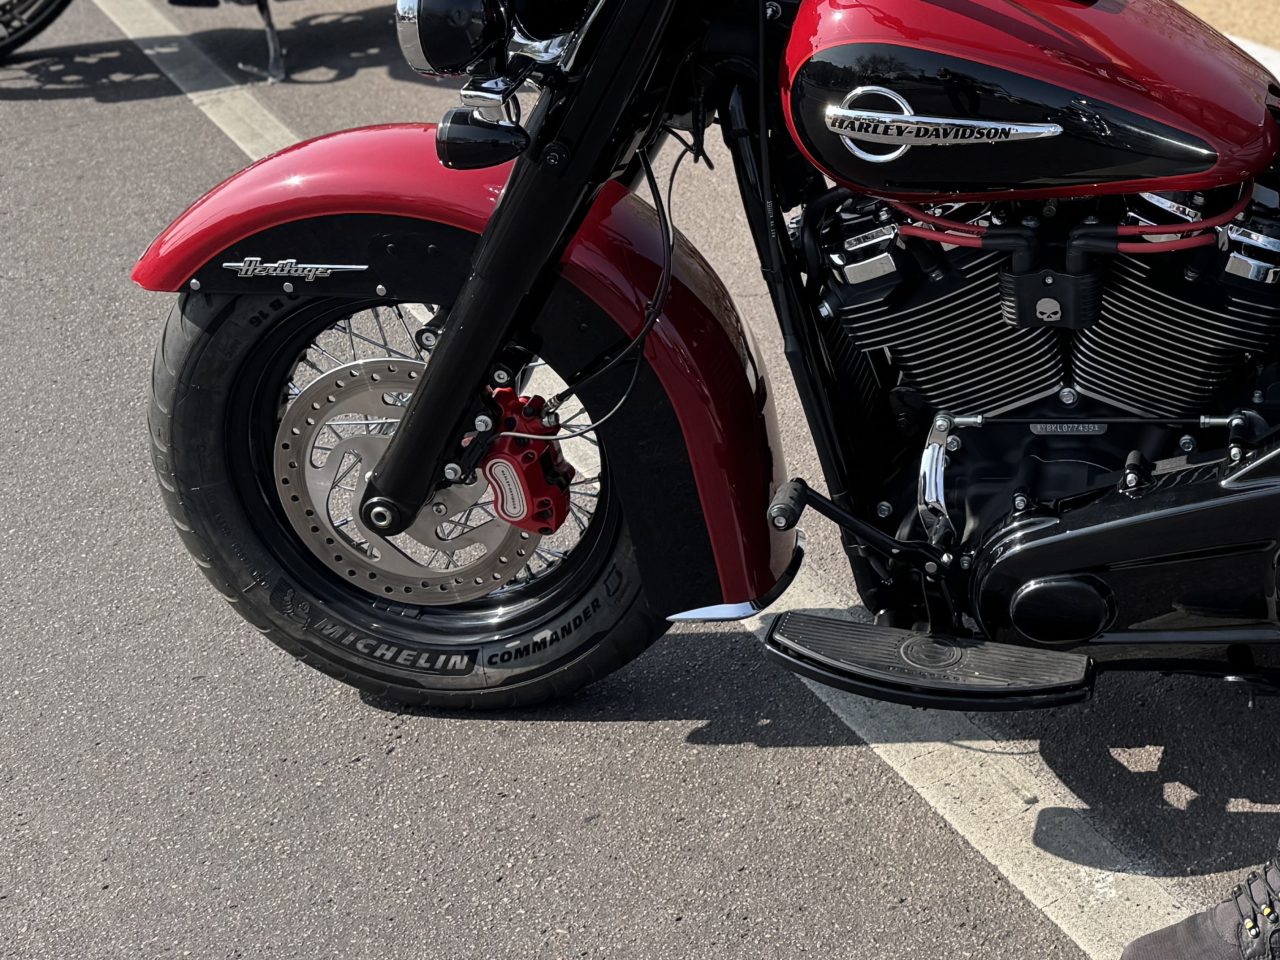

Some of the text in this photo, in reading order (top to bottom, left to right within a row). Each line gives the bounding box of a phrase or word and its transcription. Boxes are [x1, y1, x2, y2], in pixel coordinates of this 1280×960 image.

[830, 117, 1011, 140] HARLEY-DAVIDSON
[238, 257, 331, 281] Heritage
[317, 620, 470, 671] MICHELIN
[487, 598, 602, 666] COMMANDER
